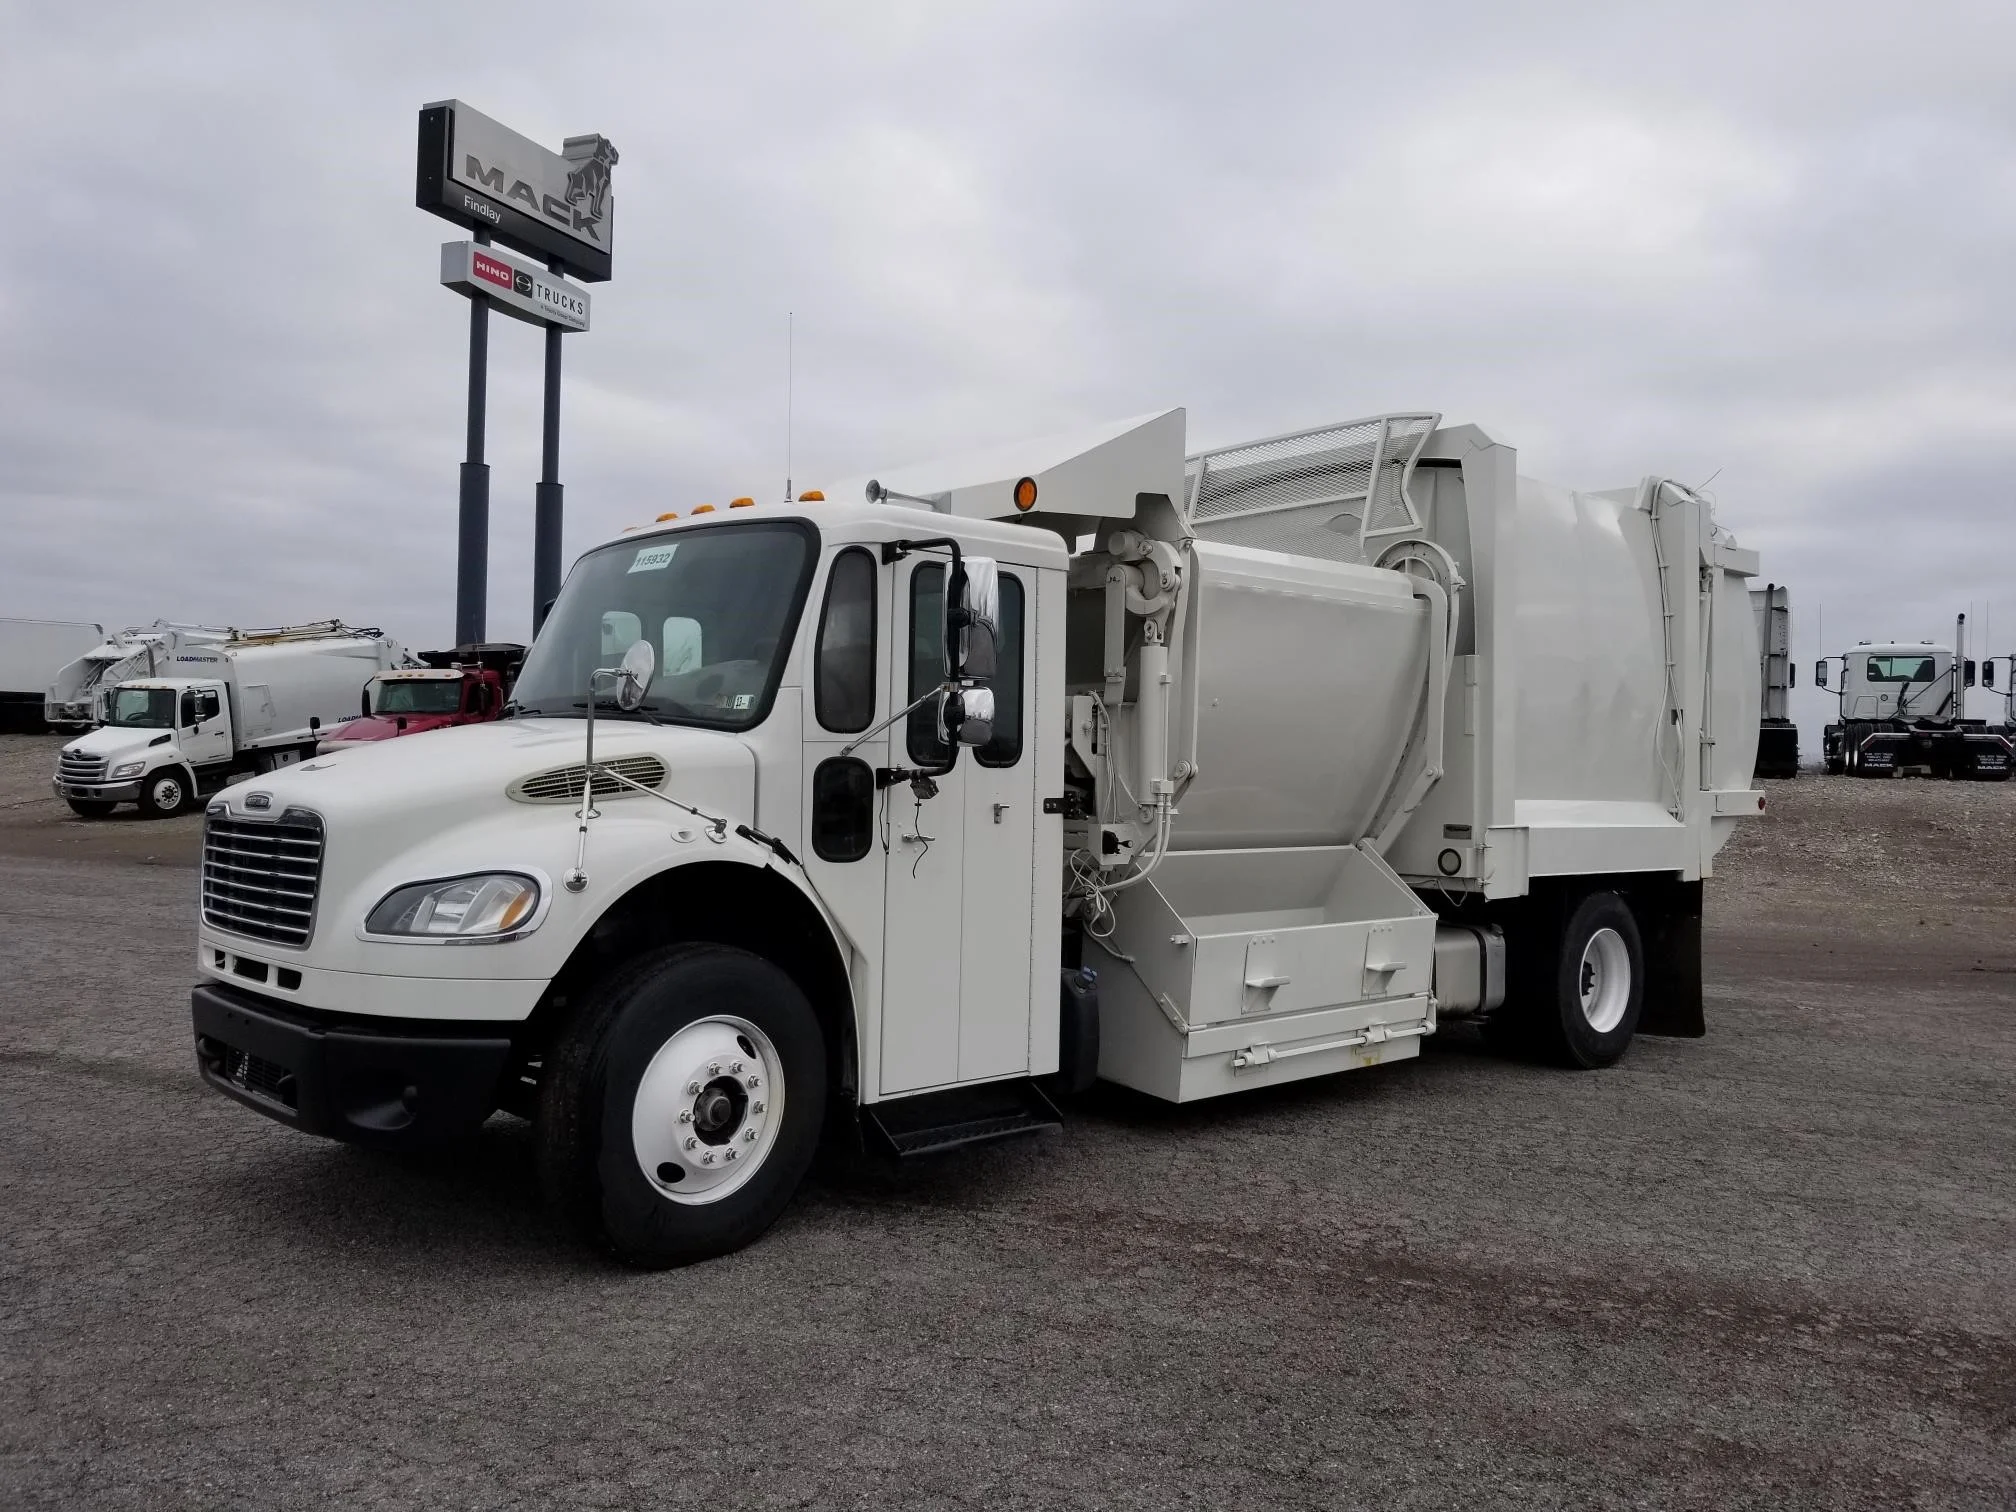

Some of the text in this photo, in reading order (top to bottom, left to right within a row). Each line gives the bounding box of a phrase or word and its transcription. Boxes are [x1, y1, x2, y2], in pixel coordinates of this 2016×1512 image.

[464, 194, 501, 224] Findlay
[466, 154, 601, 242] MACK
[476, 260, 510, 282] HINO
[536, 283, 584, 316] TRUCKS
[634, 553, 671, 567] 115932
[176, 655, 219, 664] LOADMASTER
